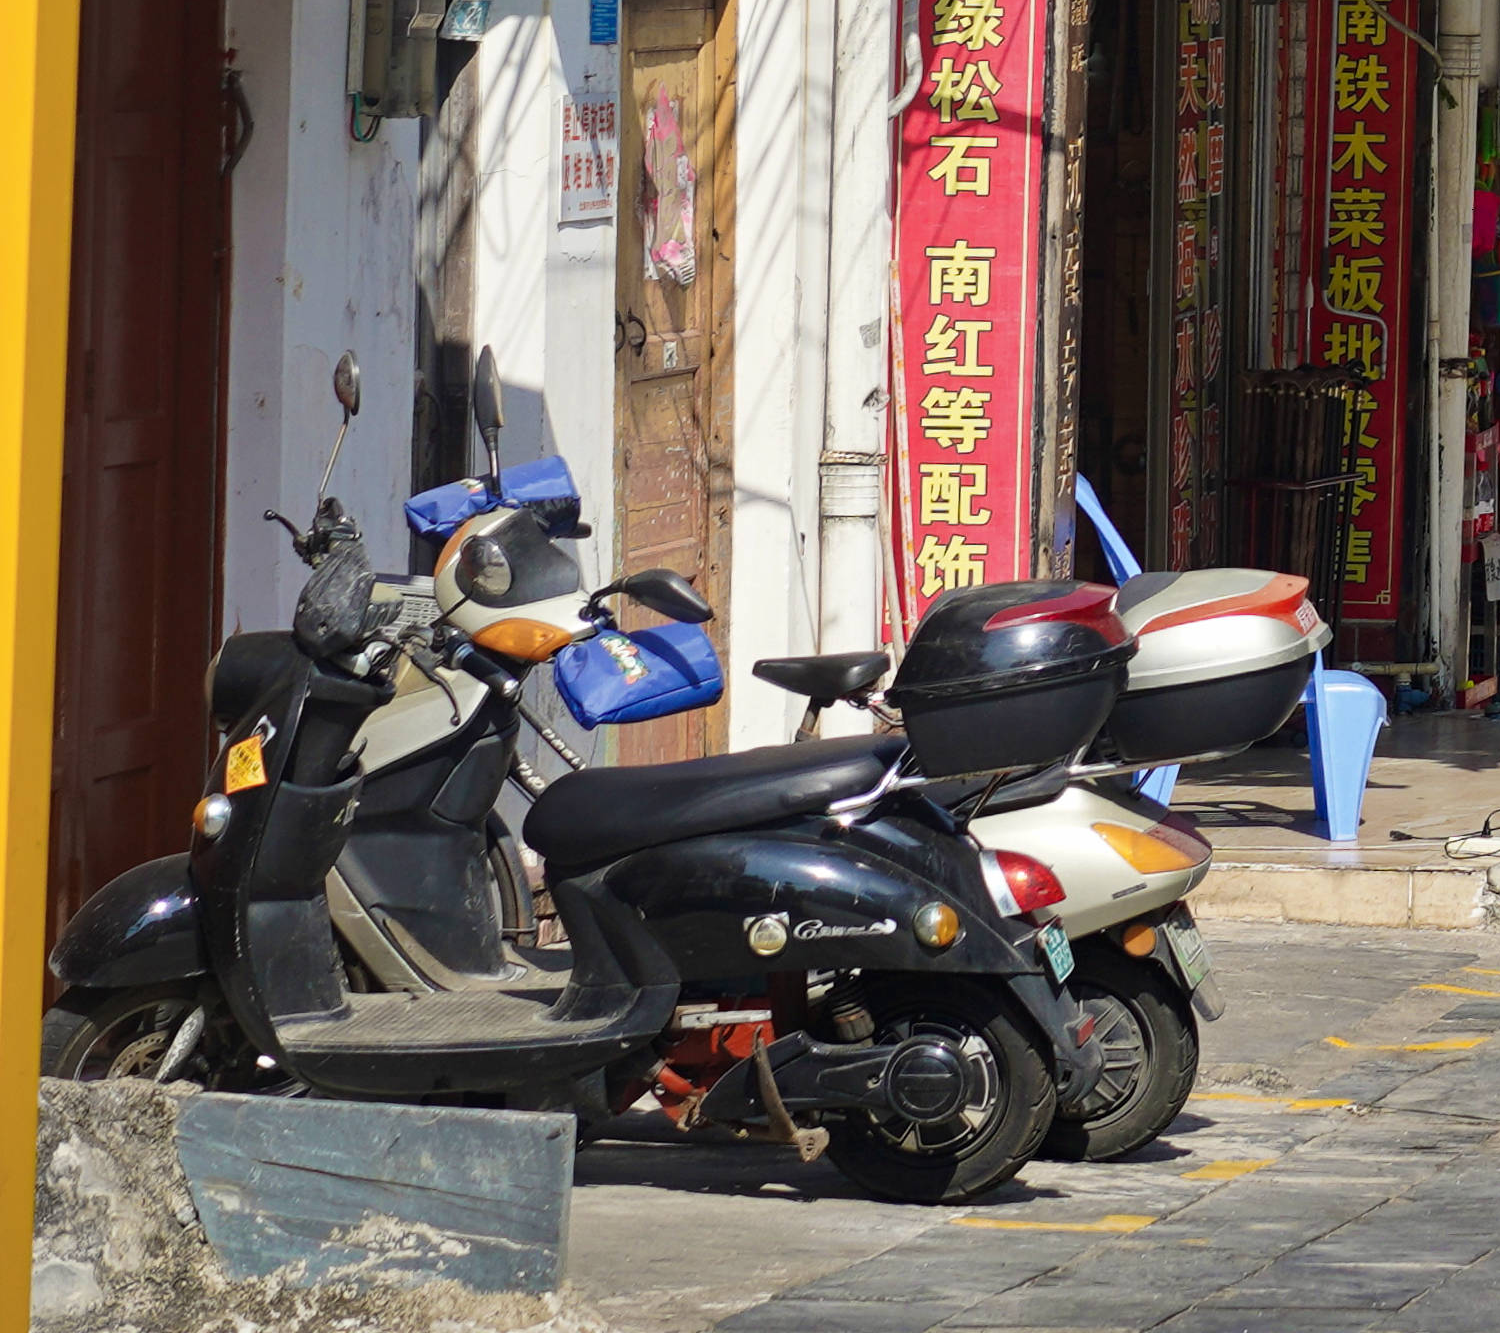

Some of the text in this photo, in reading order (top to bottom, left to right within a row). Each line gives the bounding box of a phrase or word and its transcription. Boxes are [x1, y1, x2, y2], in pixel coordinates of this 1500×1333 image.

[915, 240, 998, 597] 南红等配饰
